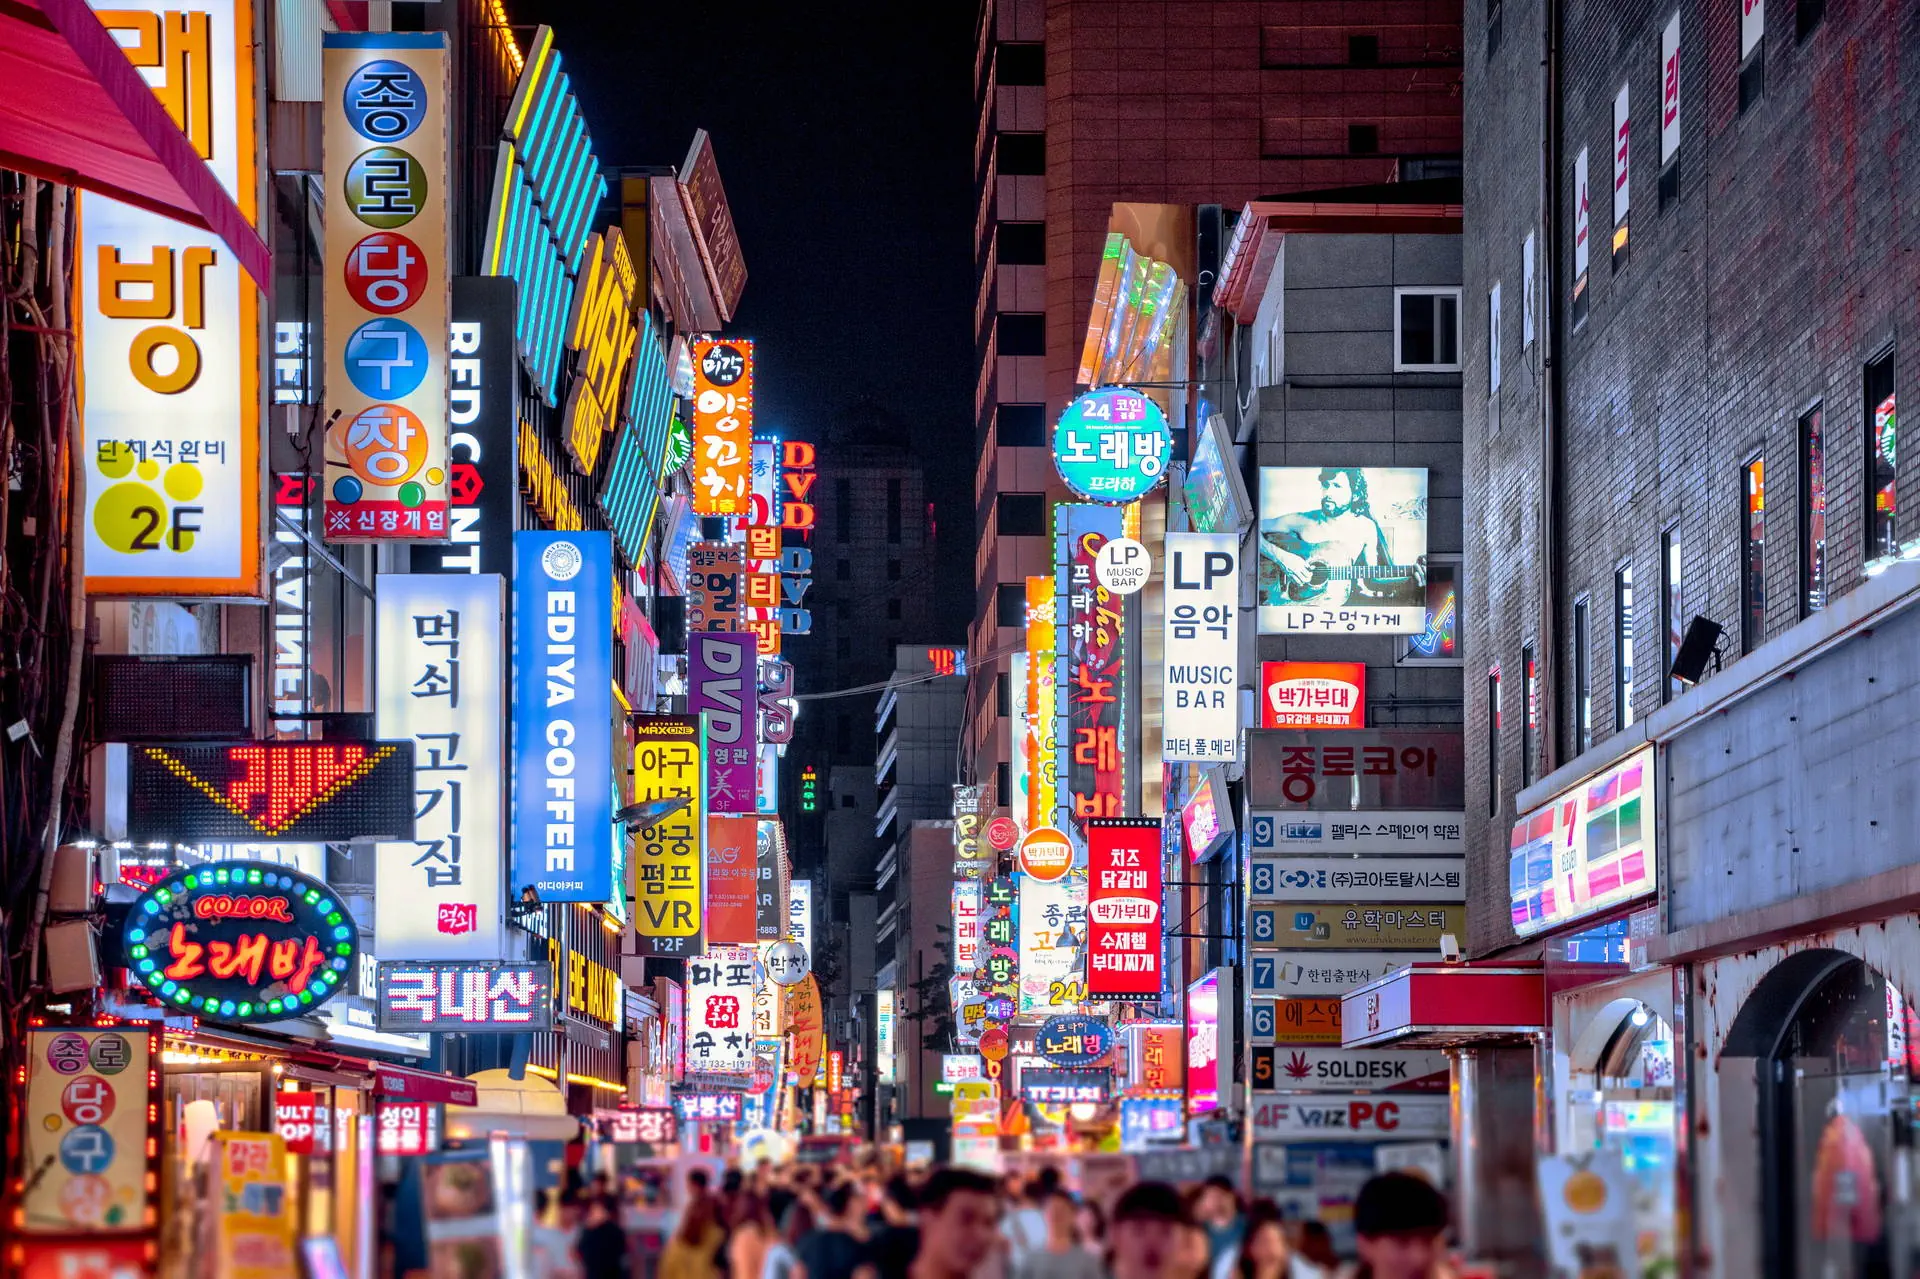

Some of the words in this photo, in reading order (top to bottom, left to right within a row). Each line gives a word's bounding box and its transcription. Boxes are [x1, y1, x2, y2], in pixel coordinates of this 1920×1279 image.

[356, 71, 417, 480] 종로당구장
[1083, 399, 1111, 421] 24
[1115, 399, 1142, 412] 코인
[697, 389, 749, 498] 양꼬치
[1061, 430, 1166, 477] 노래방
[780, 441, 817, 530] DVD
[1088, 476, 1136, 492] 프라하
[129, 505, 204, 551] 2F
[356, 508, 446, 532] 신장개업
[1110, 547, 1139, 565] LP
[1106, 568, 1144, 577] MUSIC
[1112, 578, 1137, 587] BAR
[1173, 551, 1234, 591] LP
[780, 546, 813, 634] DVD
[1072, 565, 1094, 643] 프라하
[1170, 604, 1232, 640] 음악
[1287, 611, 1315, 629] LP
[1320, 609, 1401, 629] 구멍가게
[546, 591, 576, 707] EDIYA
[1169, 665, 1233, 684] MUSIC
[701, 637, 742, 743] DVD
[1176, 690, 1225, 709] BAR
[1278, 687, 1348, 708] 박가부대
[1073, 662, 1120, 818] 노래방
[641, 747, 693, 779] 야구
[1281, 745, 1438, 804] 종로코아
[546, 720, 576, 872] COFFEE
[708, 768, 736, 800] 美
[715, 800, 731, 811] 3F
[641, 827, 694, 858] 양궁
[956, 814, 978, 859] PC
[1255, 820, 1272, 845] 9
[1331, 824, 1372, 841] 펠리스
[1375, 824, 1429, 840] 스페인어
[1433, 824, 1461, 841] 학원
[1110, 849, 1140, 867] 치즈
[537, 880, 584, 892] 이디야커피
[641, 866, 694, 895] 펌프
[1101, 870, 1148, 889] 닭갈비
[1255, 867, 1272, 892] 8
[1280, 870, 1326, 888] CORE
[1331, 871, 1461, 889] (주)코아토탈시스템
[195, 892, 292, 922] COLOR
[440, 906, 476, 931] 먹쇠
[641, 900, 694, 929] VR
[1042, 903, 1086, 927] 종로
[1097, 904, 1150, 919] 박가부대
[958, 901, 977, 960] 노래방
[989, 882, 1012, 982] 노래방
[1255, 915, 1272, 939] 8
[1342, 910, 1447, 931] 유학마스터
[1100, 931, 1147, 950] 수제햄
[164, 922, 324, 994] 노래방
[770, 955, 807, 974] 막창
[1092, 953, 1154, 972] 부대찌개
[691, 963, 752, 987] 마포
[1256, 962, 1272, 985] 7
[1307, 968, 1371, 984] 한림출판사
[387, 970, 536, 1024] 국내산
[987, 1003, 1000, 1017] 24
[1255, 1010, 1271, 1033] 6
[52, 1039, 125, 1071] 종로
[692, 1031, 753, 1058] 곱창
[1046, 1034, 1102, 1054] 노래방
[1145, 1027, 1164, 1090] 노래방
[1255, 1056, 1272, 1080] 5
[1317, 1061, 1408, 1078] SOLDESK
[946, 1065, 978, 1077] 노래방
[379, 1106, 420, 1129] 성인
[681, 1095, 737, 1119] 부동산
[1254, 1104, 1289, 1129] 4F
[1348, 1101, 1400, 1130] PC
